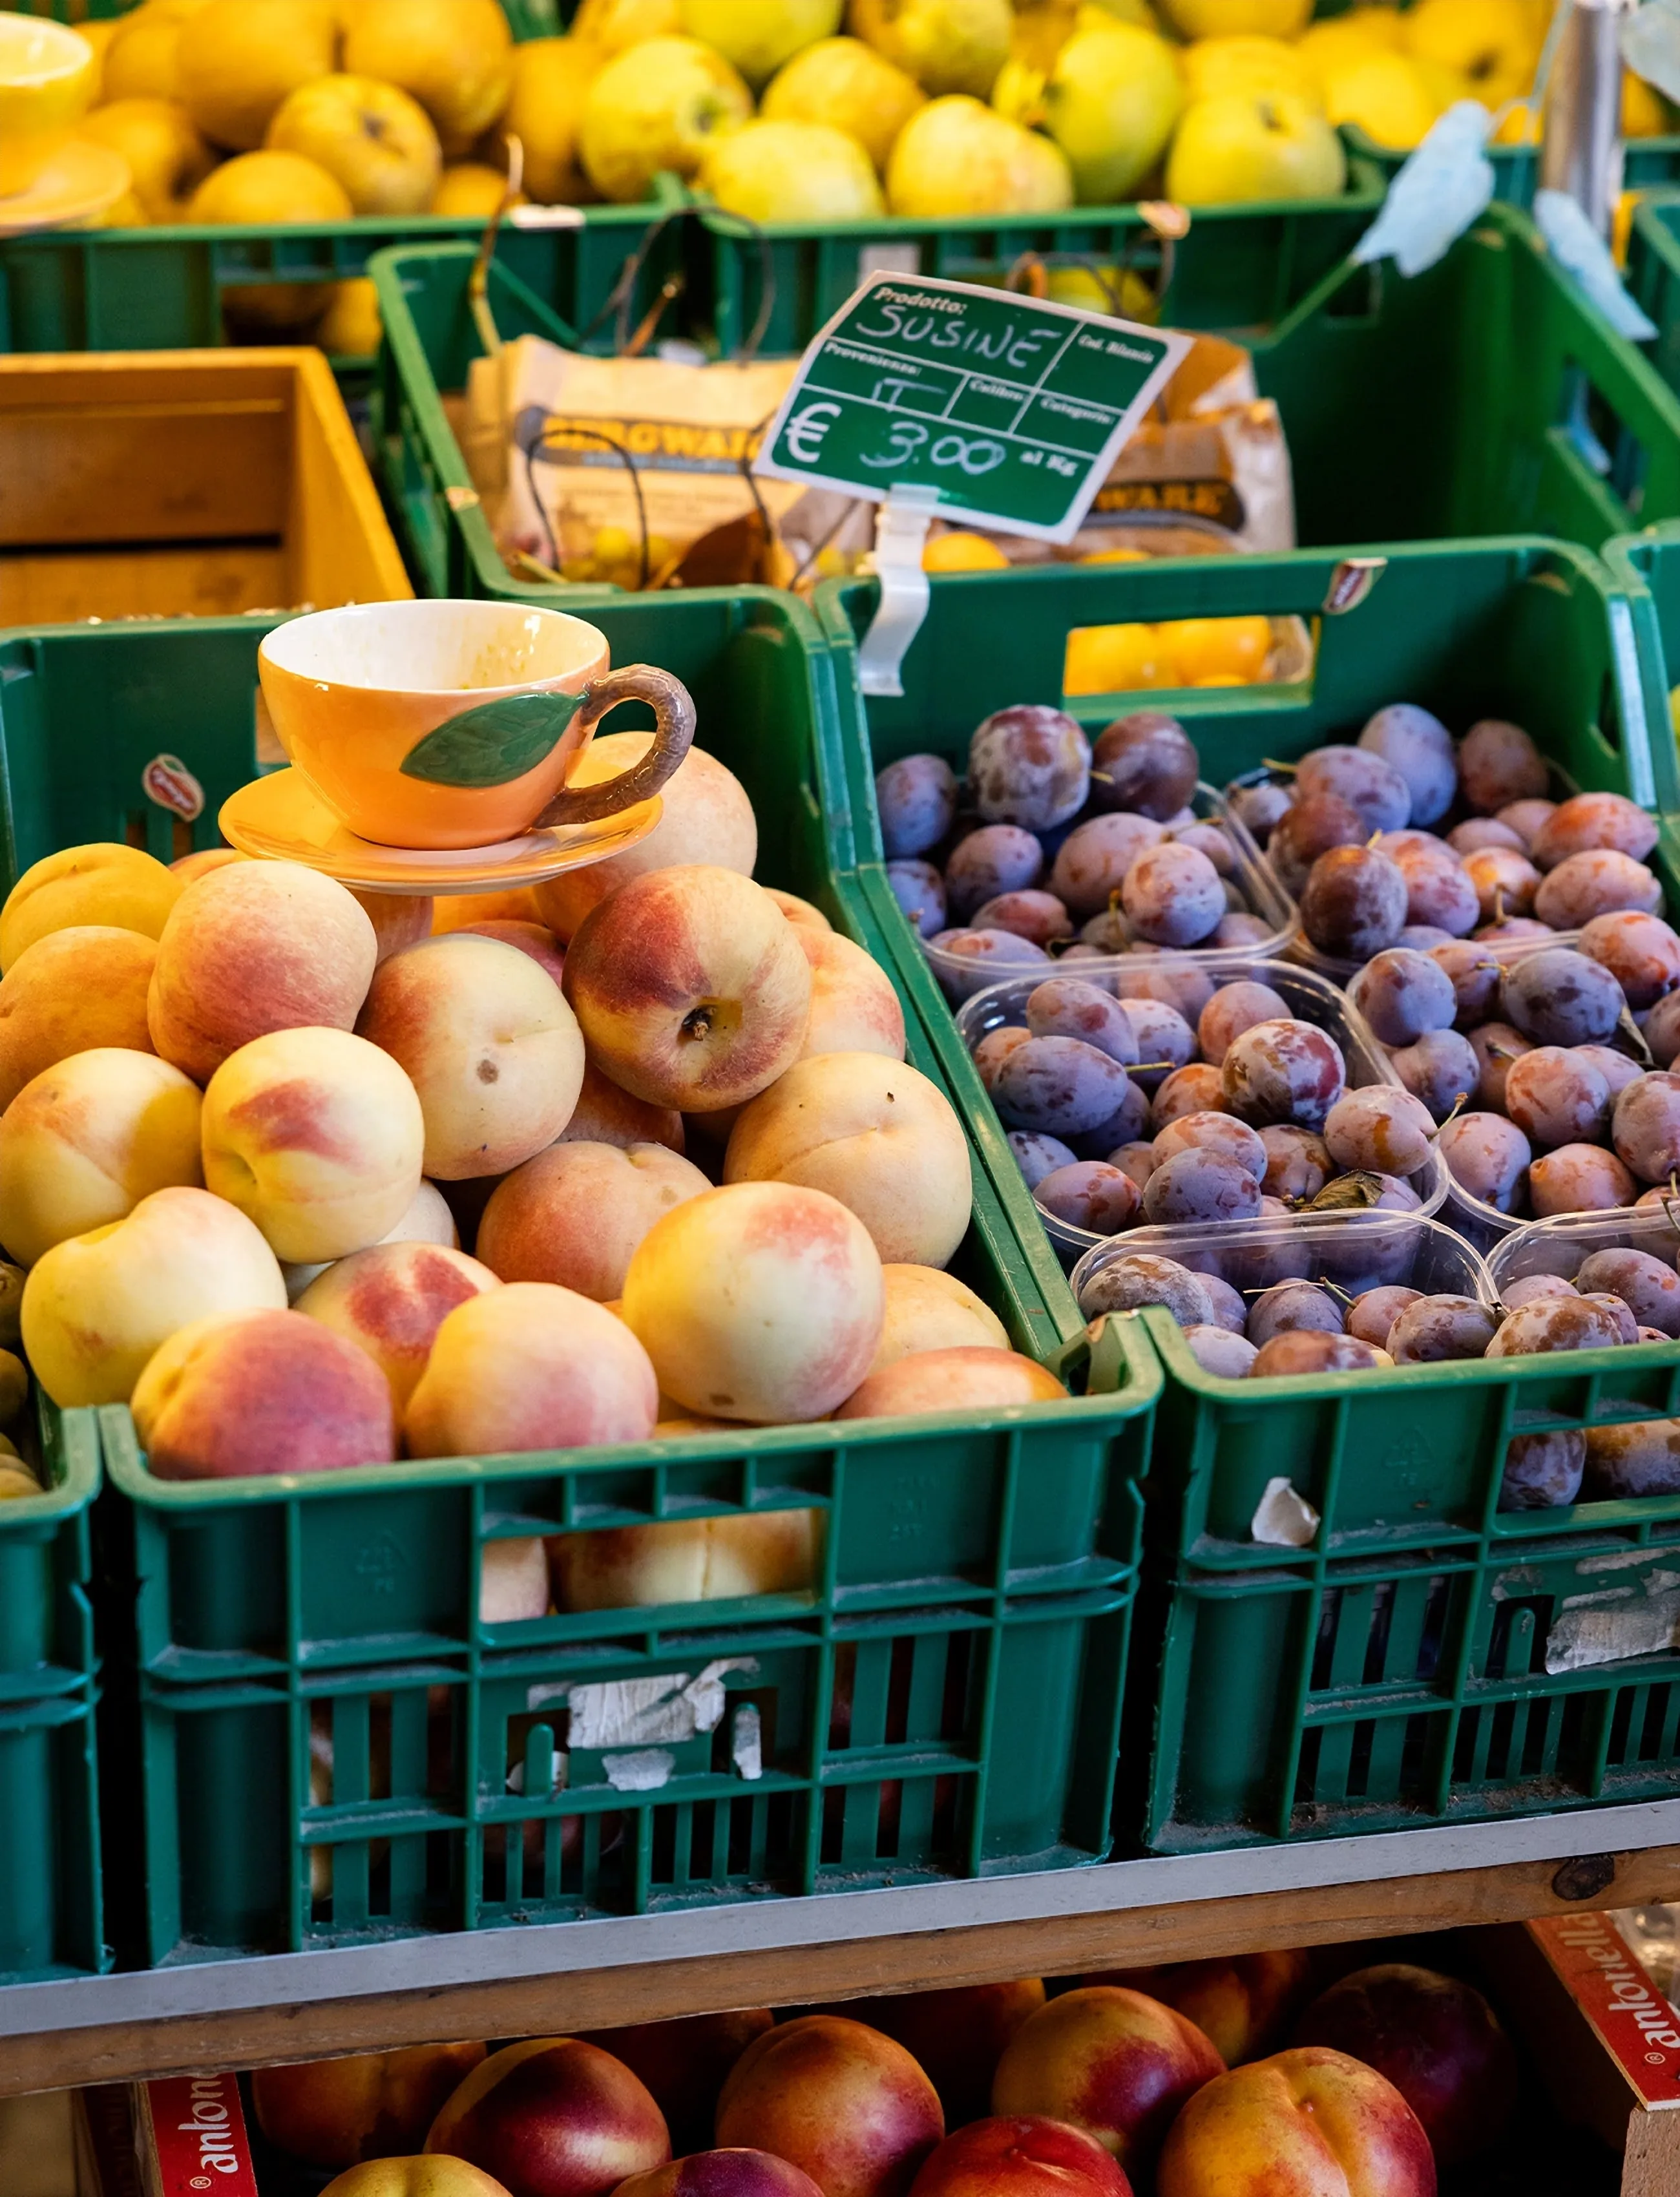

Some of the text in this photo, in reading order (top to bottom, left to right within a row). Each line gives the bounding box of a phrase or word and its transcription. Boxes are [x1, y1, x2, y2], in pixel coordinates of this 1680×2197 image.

[873, 287, 967, 315] Prodotto:
[856, 304, 1062, 368] SUSINE
[786, 402, 841, 463] €
[860, 422, 1006, 474] 3.00
[178, 2072, 238, 2173] anton
